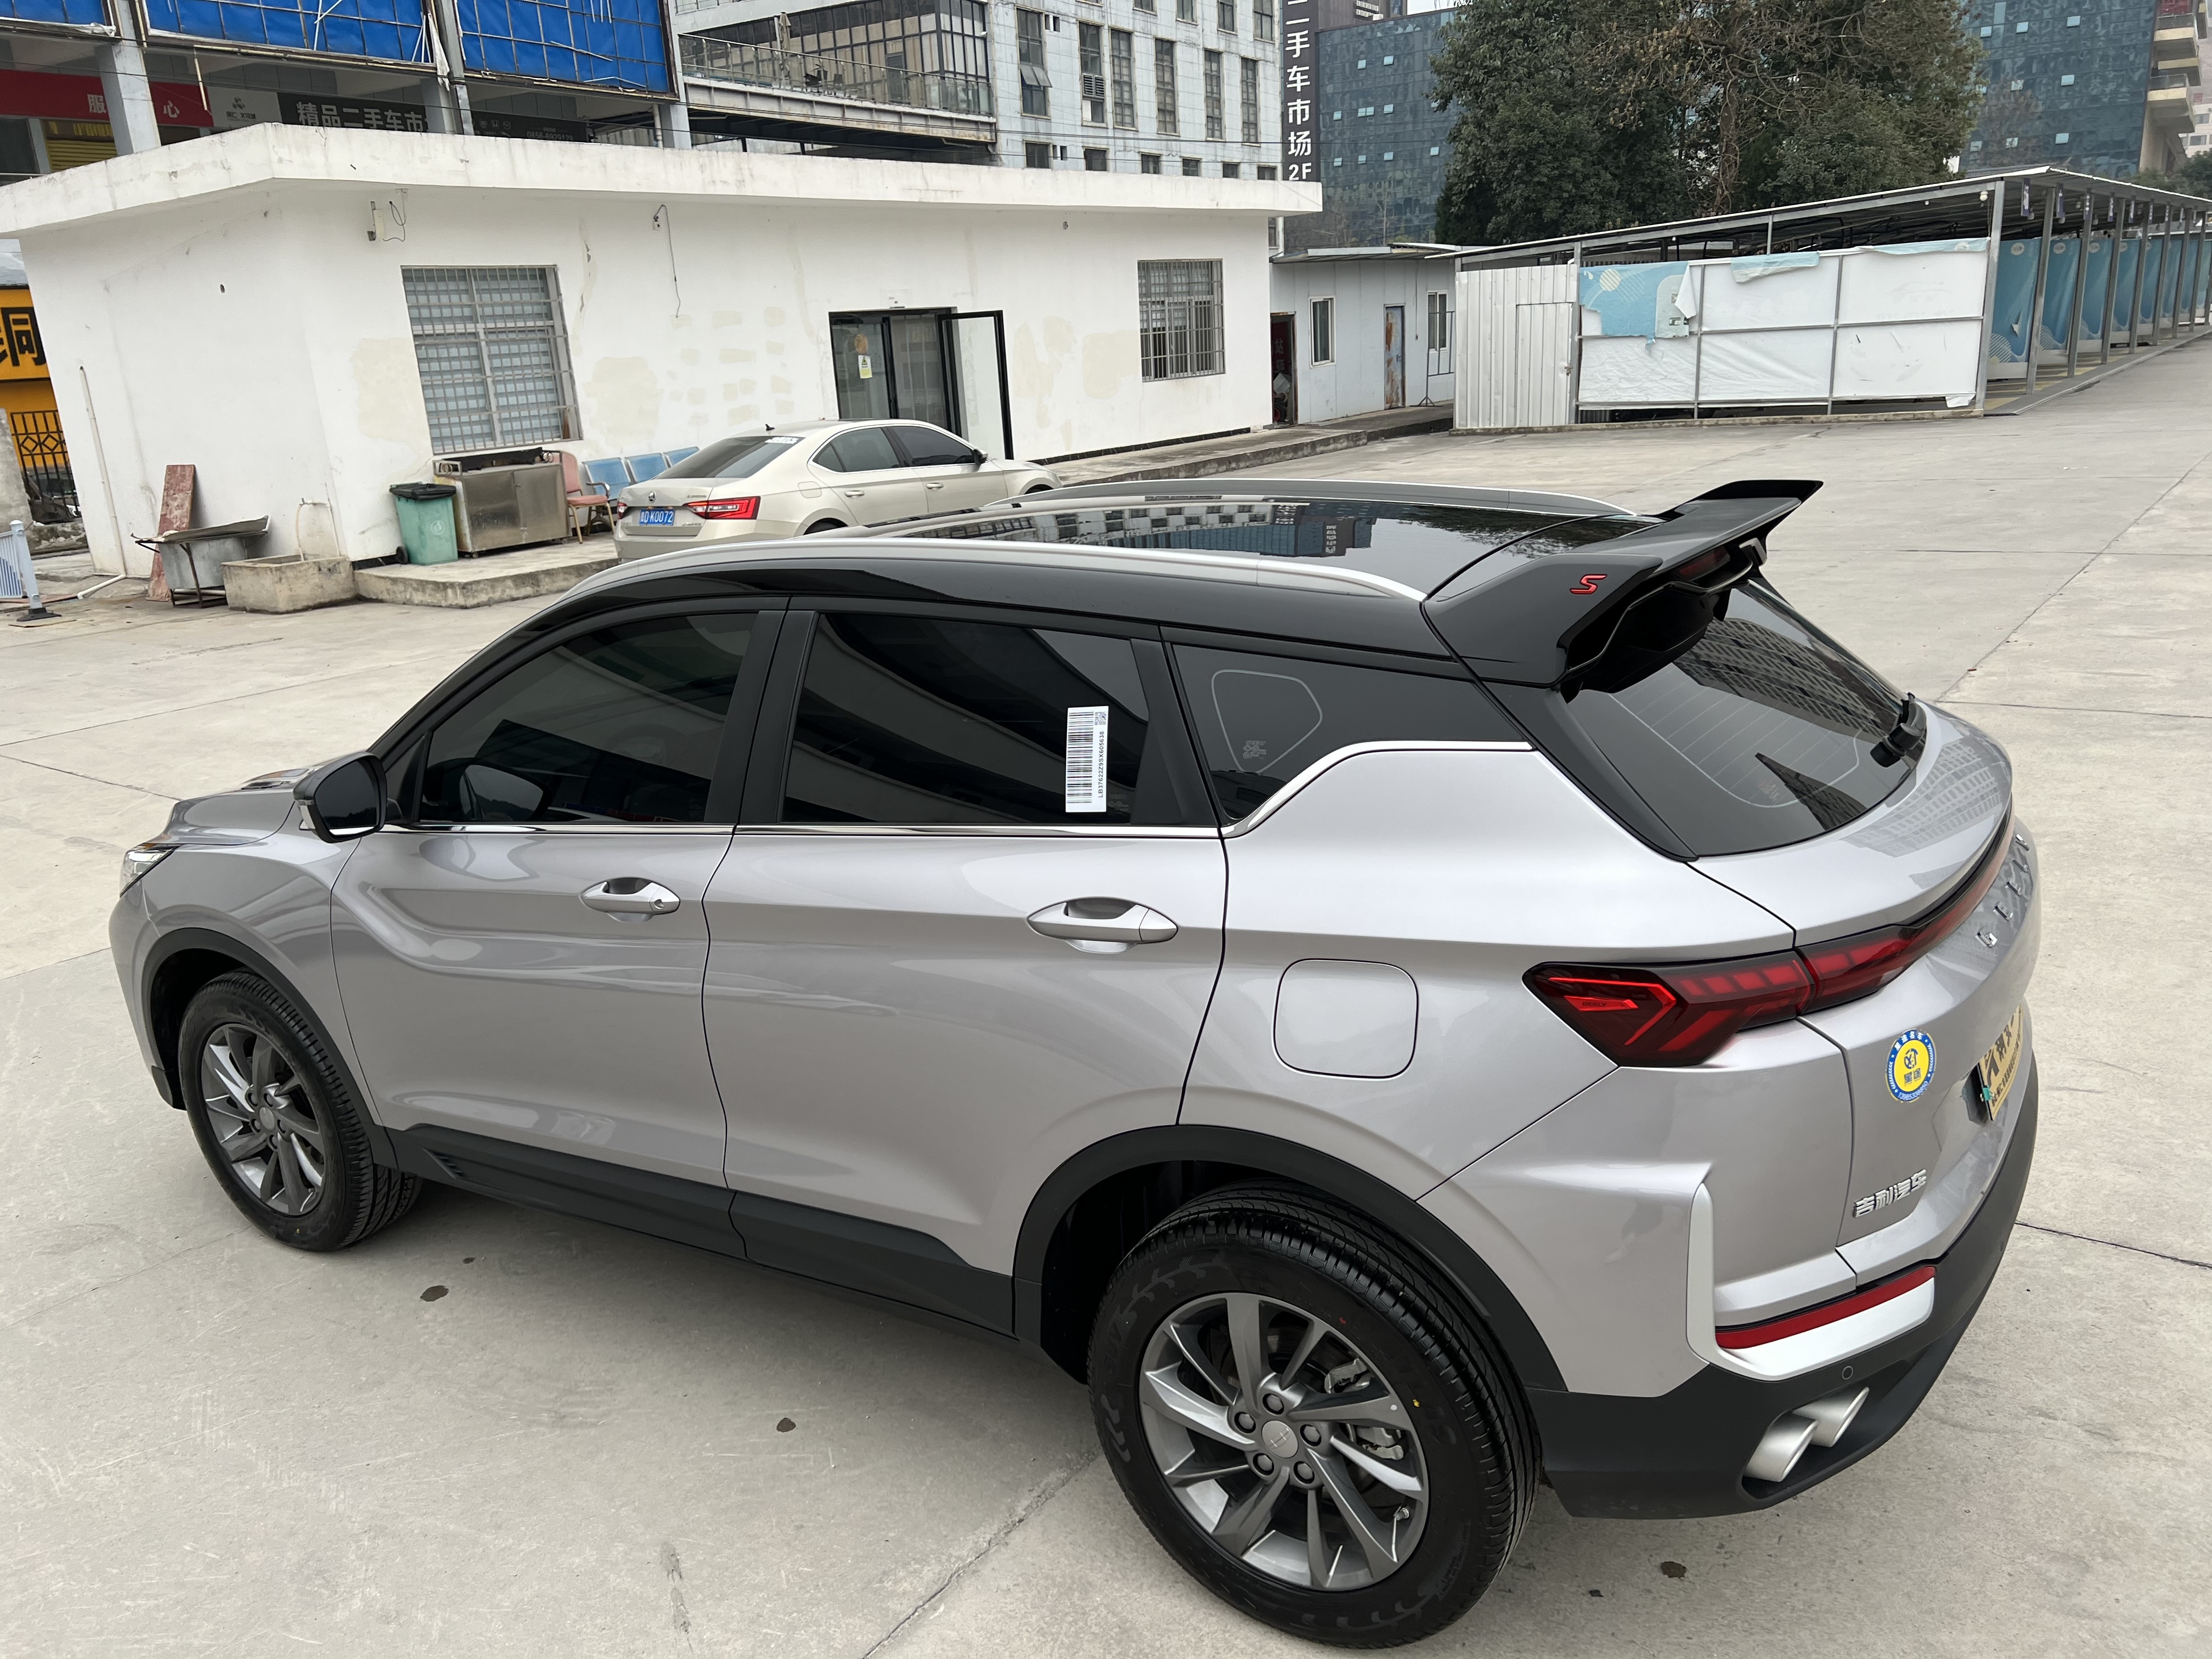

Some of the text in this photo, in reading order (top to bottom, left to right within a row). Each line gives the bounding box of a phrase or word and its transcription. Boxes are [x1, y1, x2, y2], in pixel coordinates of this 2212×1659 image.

[296, 101, 429, 132] 精品二手车市
[1570, 574, 1608, 595] S
[1853, 1169, 1927, 1218] 吉利汽车
